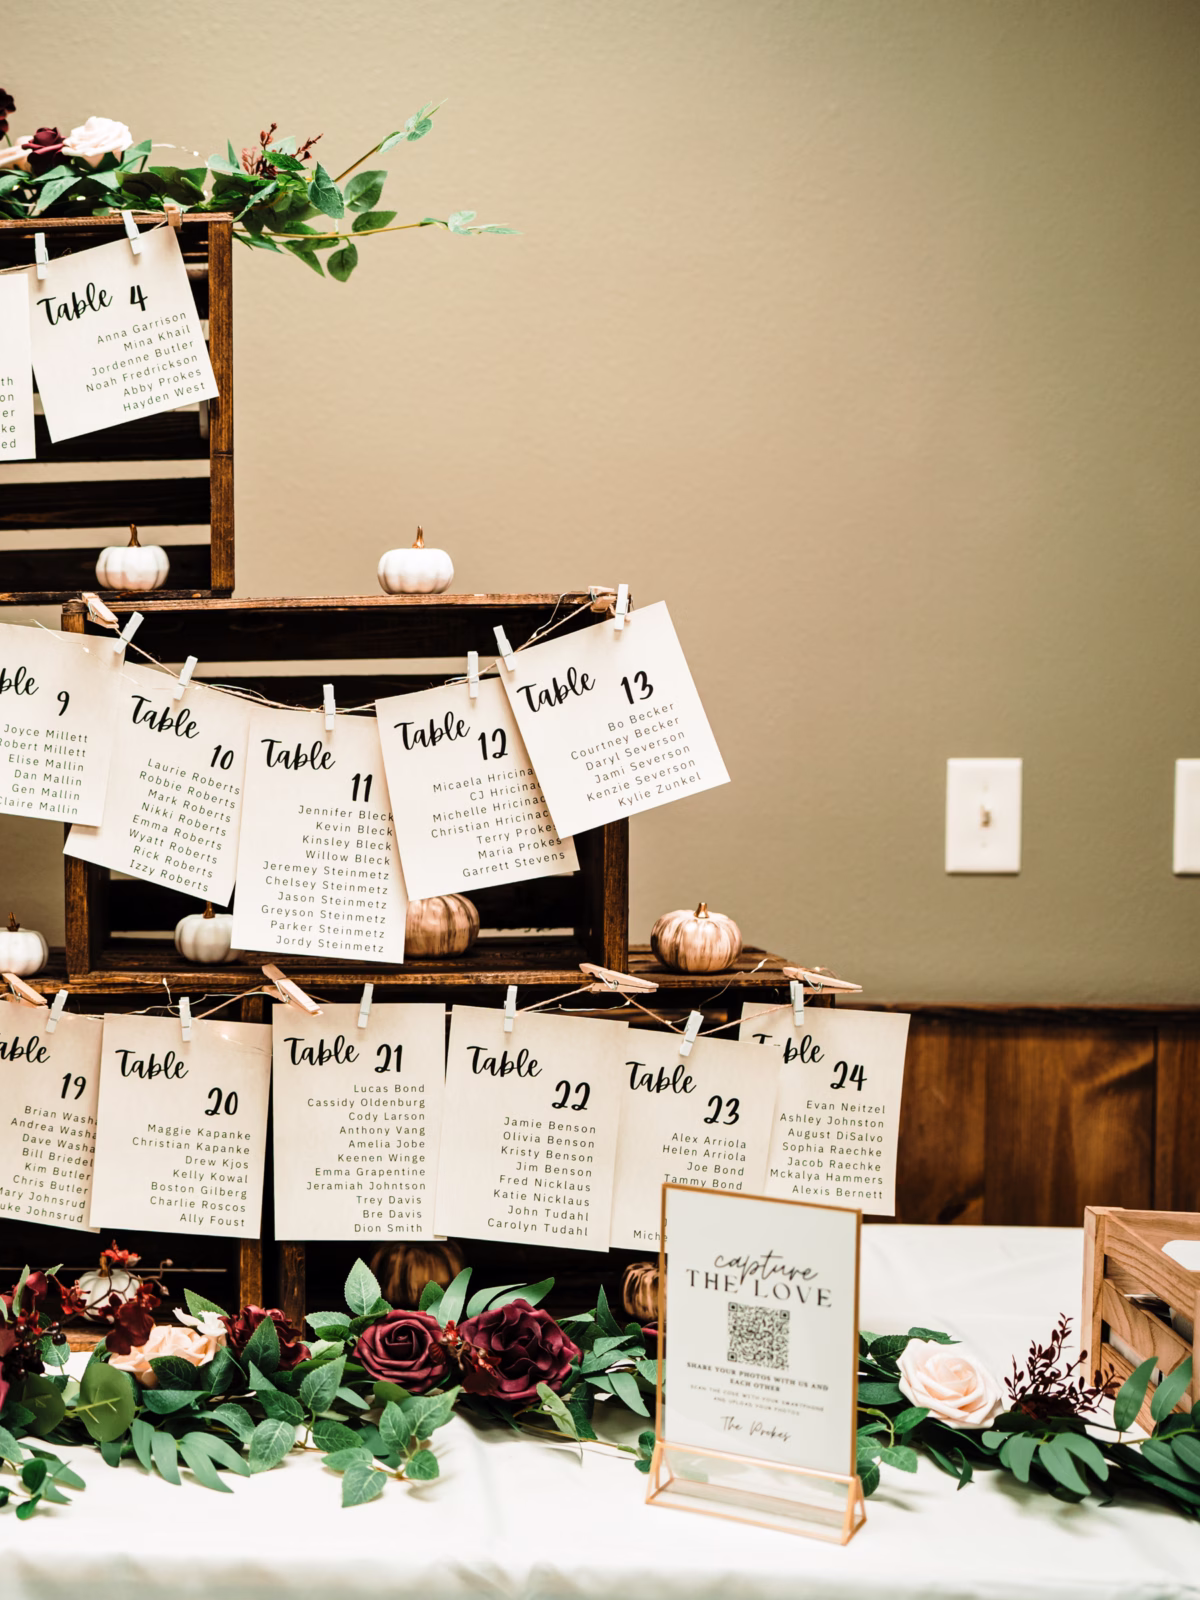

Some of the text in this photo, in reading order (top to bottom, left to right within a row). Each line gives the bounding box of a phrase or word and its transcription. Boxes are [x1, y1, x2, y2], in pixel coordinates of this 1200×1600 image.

[37, 279, 148, 325] Table 4
[85, 354, 198, 393] Noah Fredrickson
[122, 382, 205, 412] Hayden West
[516, 667, 653, 712] Table 13
[57, 691, 69, 716] 9
[3, 723, 88, 744] Joyce Millett
[132, 695, 234, 770] Table 10
[394, 711, 508, 760] Table 12
[570, 717, 679, 760] Courtney Becker
[147, 758, 240, 795] Laurie Roberts
[261, 739, 372, 802] Table 11
[617, 771, 701, 807] Kylie Zunkel
[39, 801, 78, 815] Mallin
[129, 828, 218, 865] Wyatt Roberts
[262, 860, 389, 881] Jeremey Steinmetz
[462, 851, 566, 878] Garrett Stevens
[276, 934, 384, 953] Jordy Steinmetz
[284, 1035, 402, 1073] Table 21
[61, 1073, 86, 1100] 19
[115, 1050, 238, 1116] Table 20
[467, 1046, 590, 1111] Table 22
[830, 1061, 867, 1091] 24
[307, 1097, 426, 1109] Cassidy Oldenburg
[625, 1061, 739, 1125] Table 23
[779, 1112, 884, 1128] Ashley Johnston
[662, 1144, 746, 1162] Helen Arriola
[306, 1181, 426, 1191] Jeramiah Johntson
[499, 1174, 591, 1192] Fred Nicklaus
[770, 1168, 883, 1185] Mckalya Hammers
[26, 1205, 84, 1223] Johnsrud
[28, 1191, 86, 1210] Johnsrud
[149, 1195, 246, 1213] Charlie Roscos
[179, 1213, 245, 1227] Ally Foust
[487, 1217, 588, 1237] Carolyn Tudahl
[714, 1250, 818, 1285] capture
[686, 1269, 832, 1308] THE LOVE
[686, 1362, 712, 1371] SHARE
[715, 1366, 736, 1375] YOUR
[739, 1370, 771, 1381] PHOTOS
[730, 1378, 780, 1392] EACH OTHER
